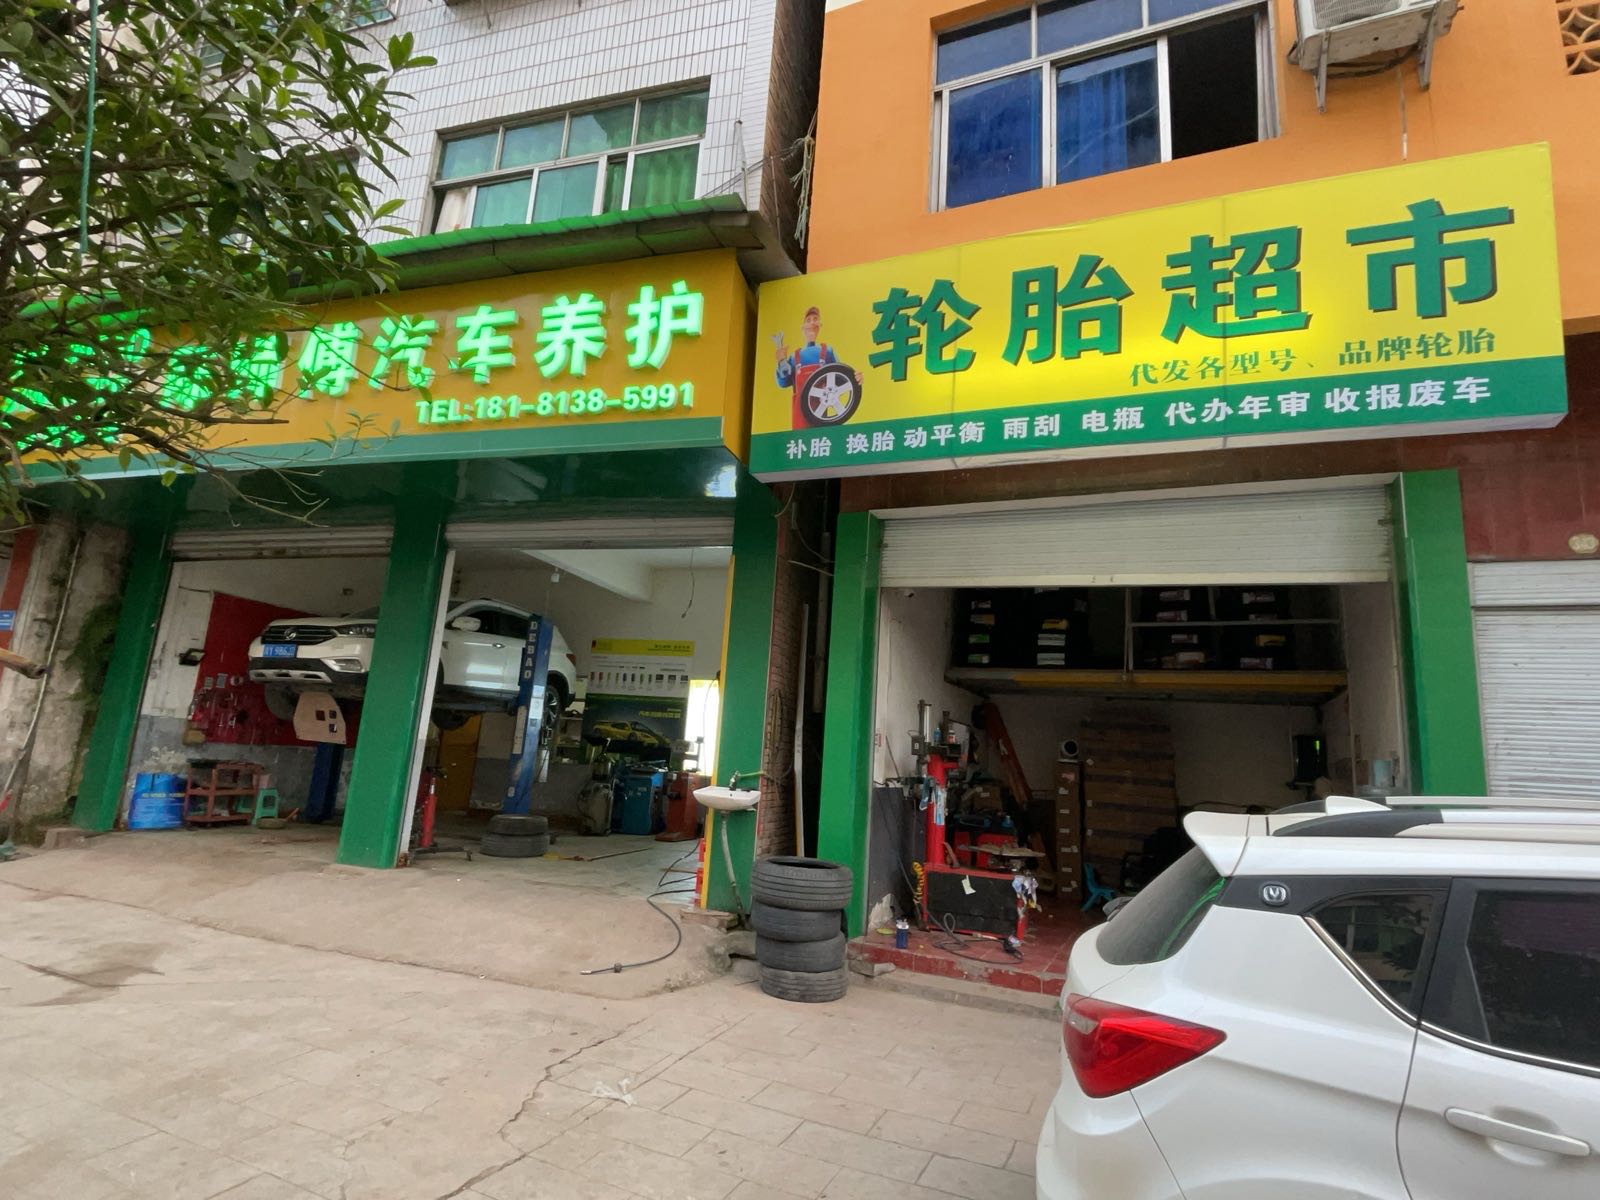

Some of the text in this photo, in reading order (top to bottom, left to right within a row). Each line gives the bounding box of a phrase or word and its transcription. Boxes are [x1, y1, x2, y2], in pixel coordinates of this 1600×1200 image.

[868, 198, 1514, 382] 轮胎超市
[786, 377, 1491, 459] 补胎 换胎 动平衡 雨刮 电瓶 代办年审 收报废车
